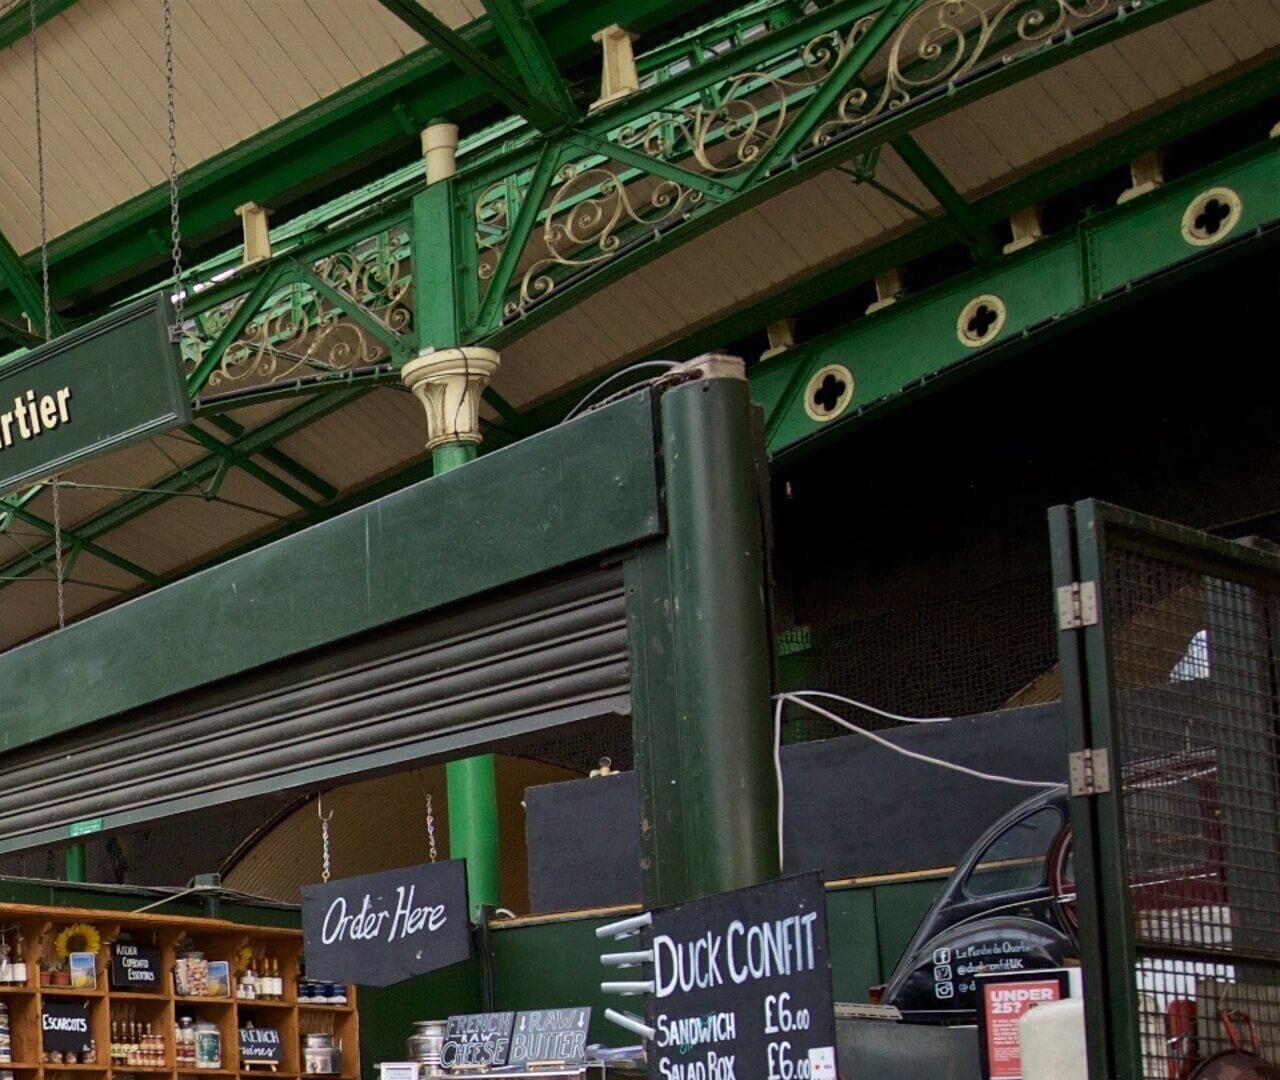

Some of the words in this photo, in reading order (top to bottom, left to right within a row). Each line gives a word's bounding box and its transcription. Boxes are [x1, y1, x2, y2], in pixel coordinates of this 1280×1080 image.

[322, 894, 390, 944] Order
[388, 884, 447, 942] Here
[991, 987, 1054, 1002] UNDER
[529, 1009, 576, 1032] RAW
[991, 1002, 1022, 1014] 25?
[445, 1013, 511, 1040] FRENCH
[461, 1032, 493, 1043] RAW
[439, 1038, 509, 1069] CHEESE
[510, 1030, 586, 1061] BUTTER
